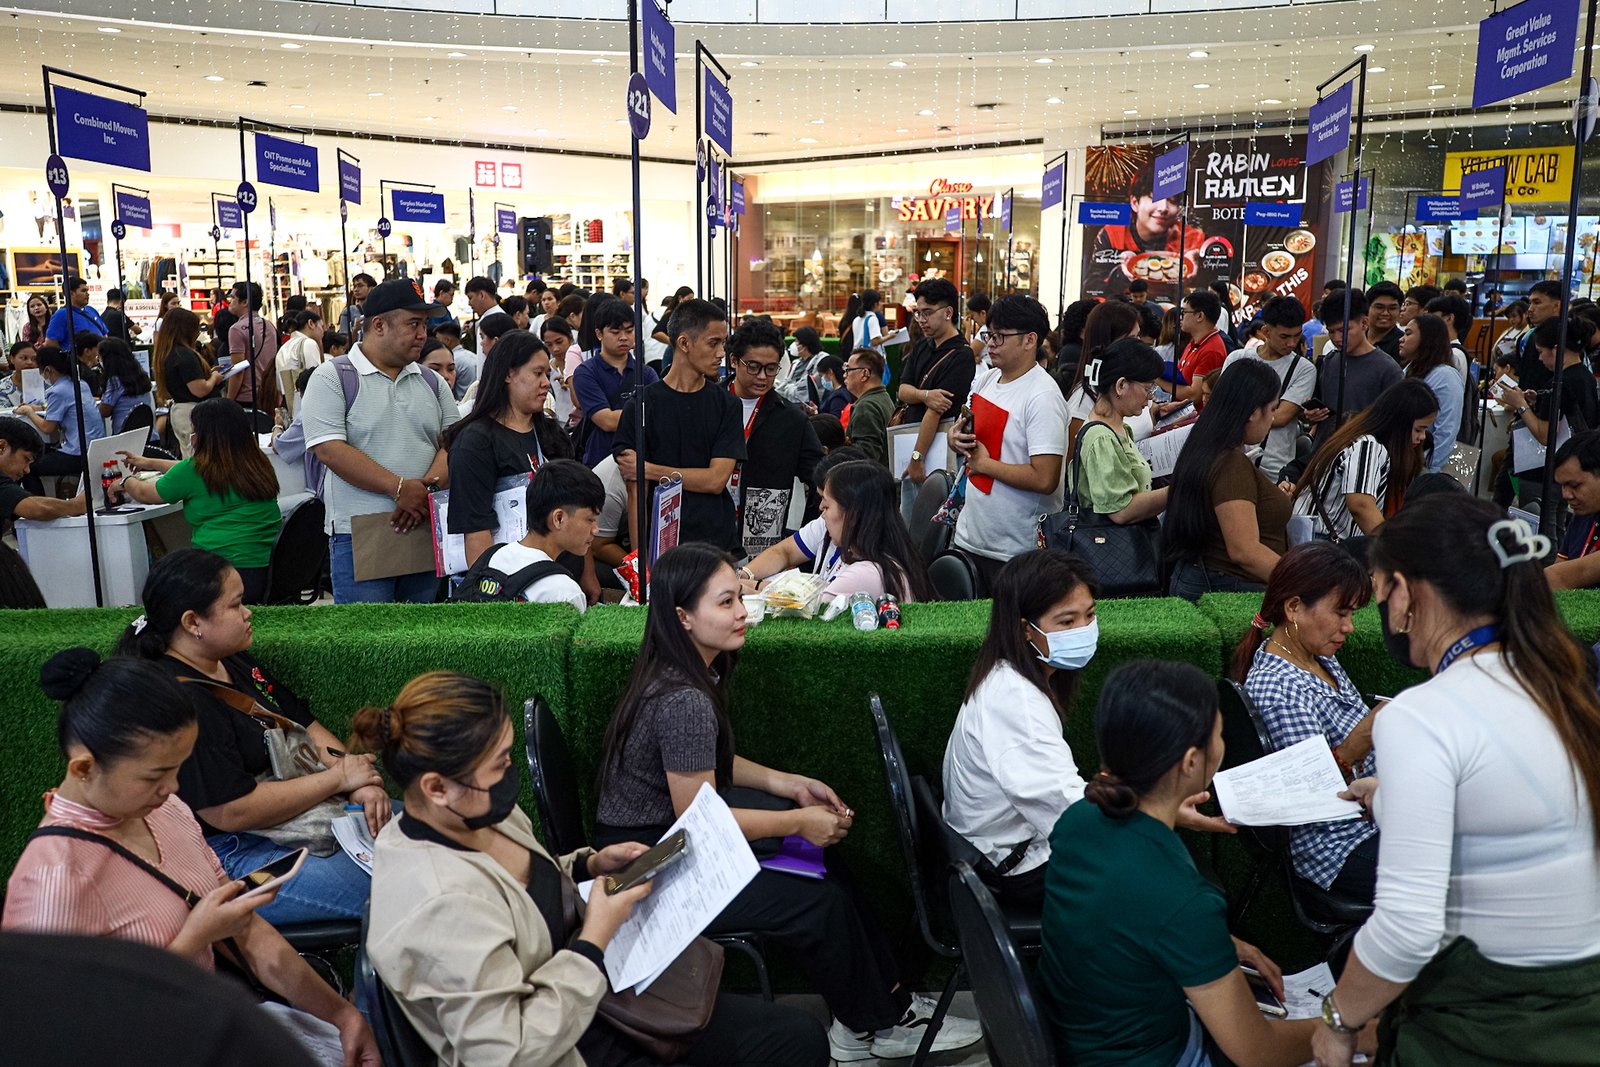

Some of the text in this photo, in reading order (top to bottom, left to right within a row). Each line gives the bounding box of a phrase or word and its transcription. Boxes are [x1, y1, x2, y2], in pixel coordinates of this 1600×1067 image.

[1505, 13, 1552, 42] Great Value
[1496, 31, 1557, 64] Mgmt. Services
[1500, 53, 1548, 79] Corporation
[629, 90, 649, 120] #21
[1330, 103, 1348, 123] Integrated
[74, 113, 139, 139] Combined Movers,
[103, 132, 116, 145] Inc.
[264, 150, 311, 168] CNT Promo and Ads
[269, 161, 307, 176] Specialists, Inc.
[1206, 152, 1300, 178] RABIN LOVES
[1525, 153, 1560, 183] CAB
[48, 168, 67, 185] #13
[1475, 182, 1490, 190] Bridges
[1205, 174, 1295, 199] RAMEN
[1485, 188, 1495, 197] Corp.
[238, 190, 255, 205] #12
[400, 200, 437, 210] Surplus Marketing
[113, 225, 123, 236] #3
[378, 222, 390, 231] #10
[1275, 267, 1309, 297] THIS
